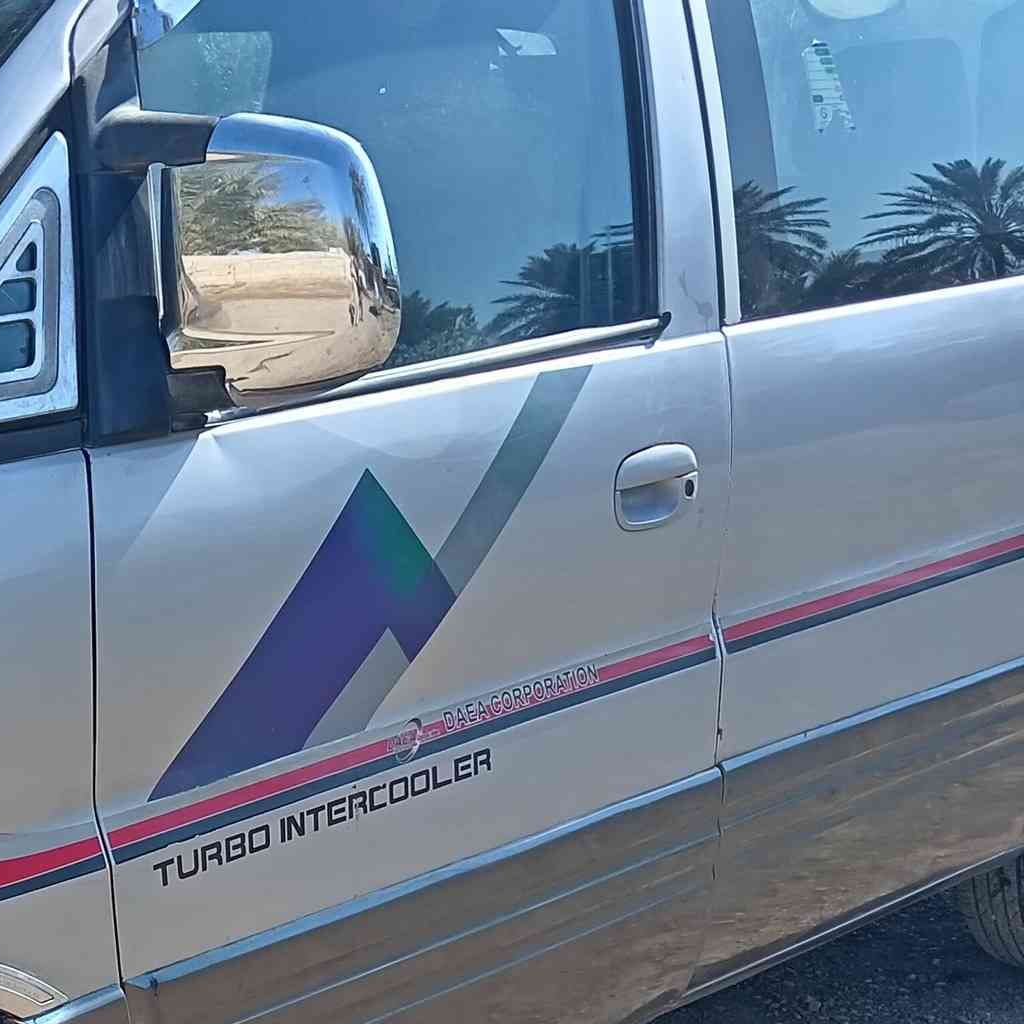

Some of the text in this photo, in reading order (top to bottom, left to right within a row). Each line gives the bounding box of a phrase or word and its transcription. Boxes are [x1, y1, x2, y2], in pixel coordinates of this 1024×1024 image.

[443, 664, 600, 731] DAEA CORPORATION
[153, 748, 492, 887] TURBO INTERCOOLER
